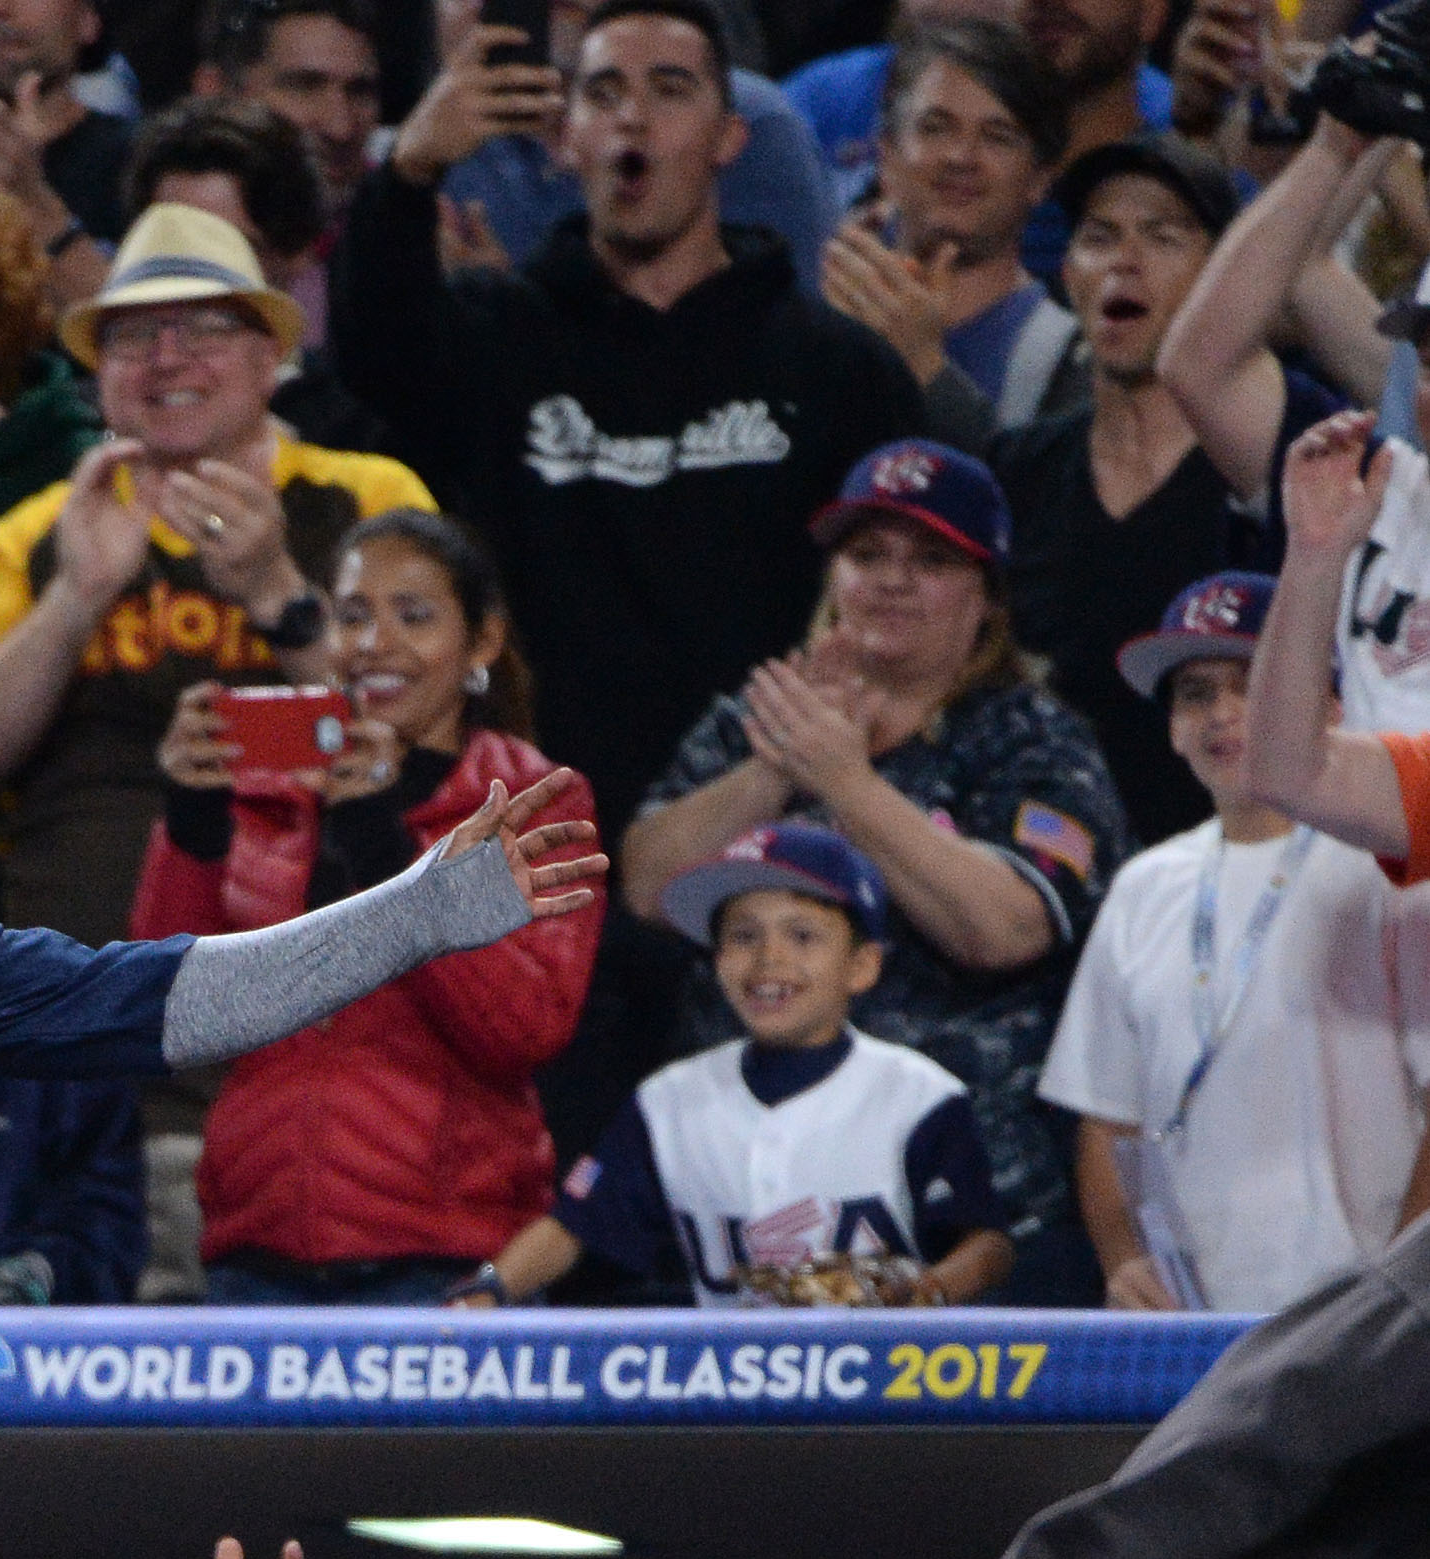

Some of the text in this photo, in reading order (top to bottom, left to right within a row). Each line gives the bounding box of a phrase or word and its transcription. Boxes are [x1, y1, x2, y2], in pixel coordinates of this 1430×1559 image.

[21, 1342, 1049, 1401] WORLD BASEBALL CLASSIC 2017
